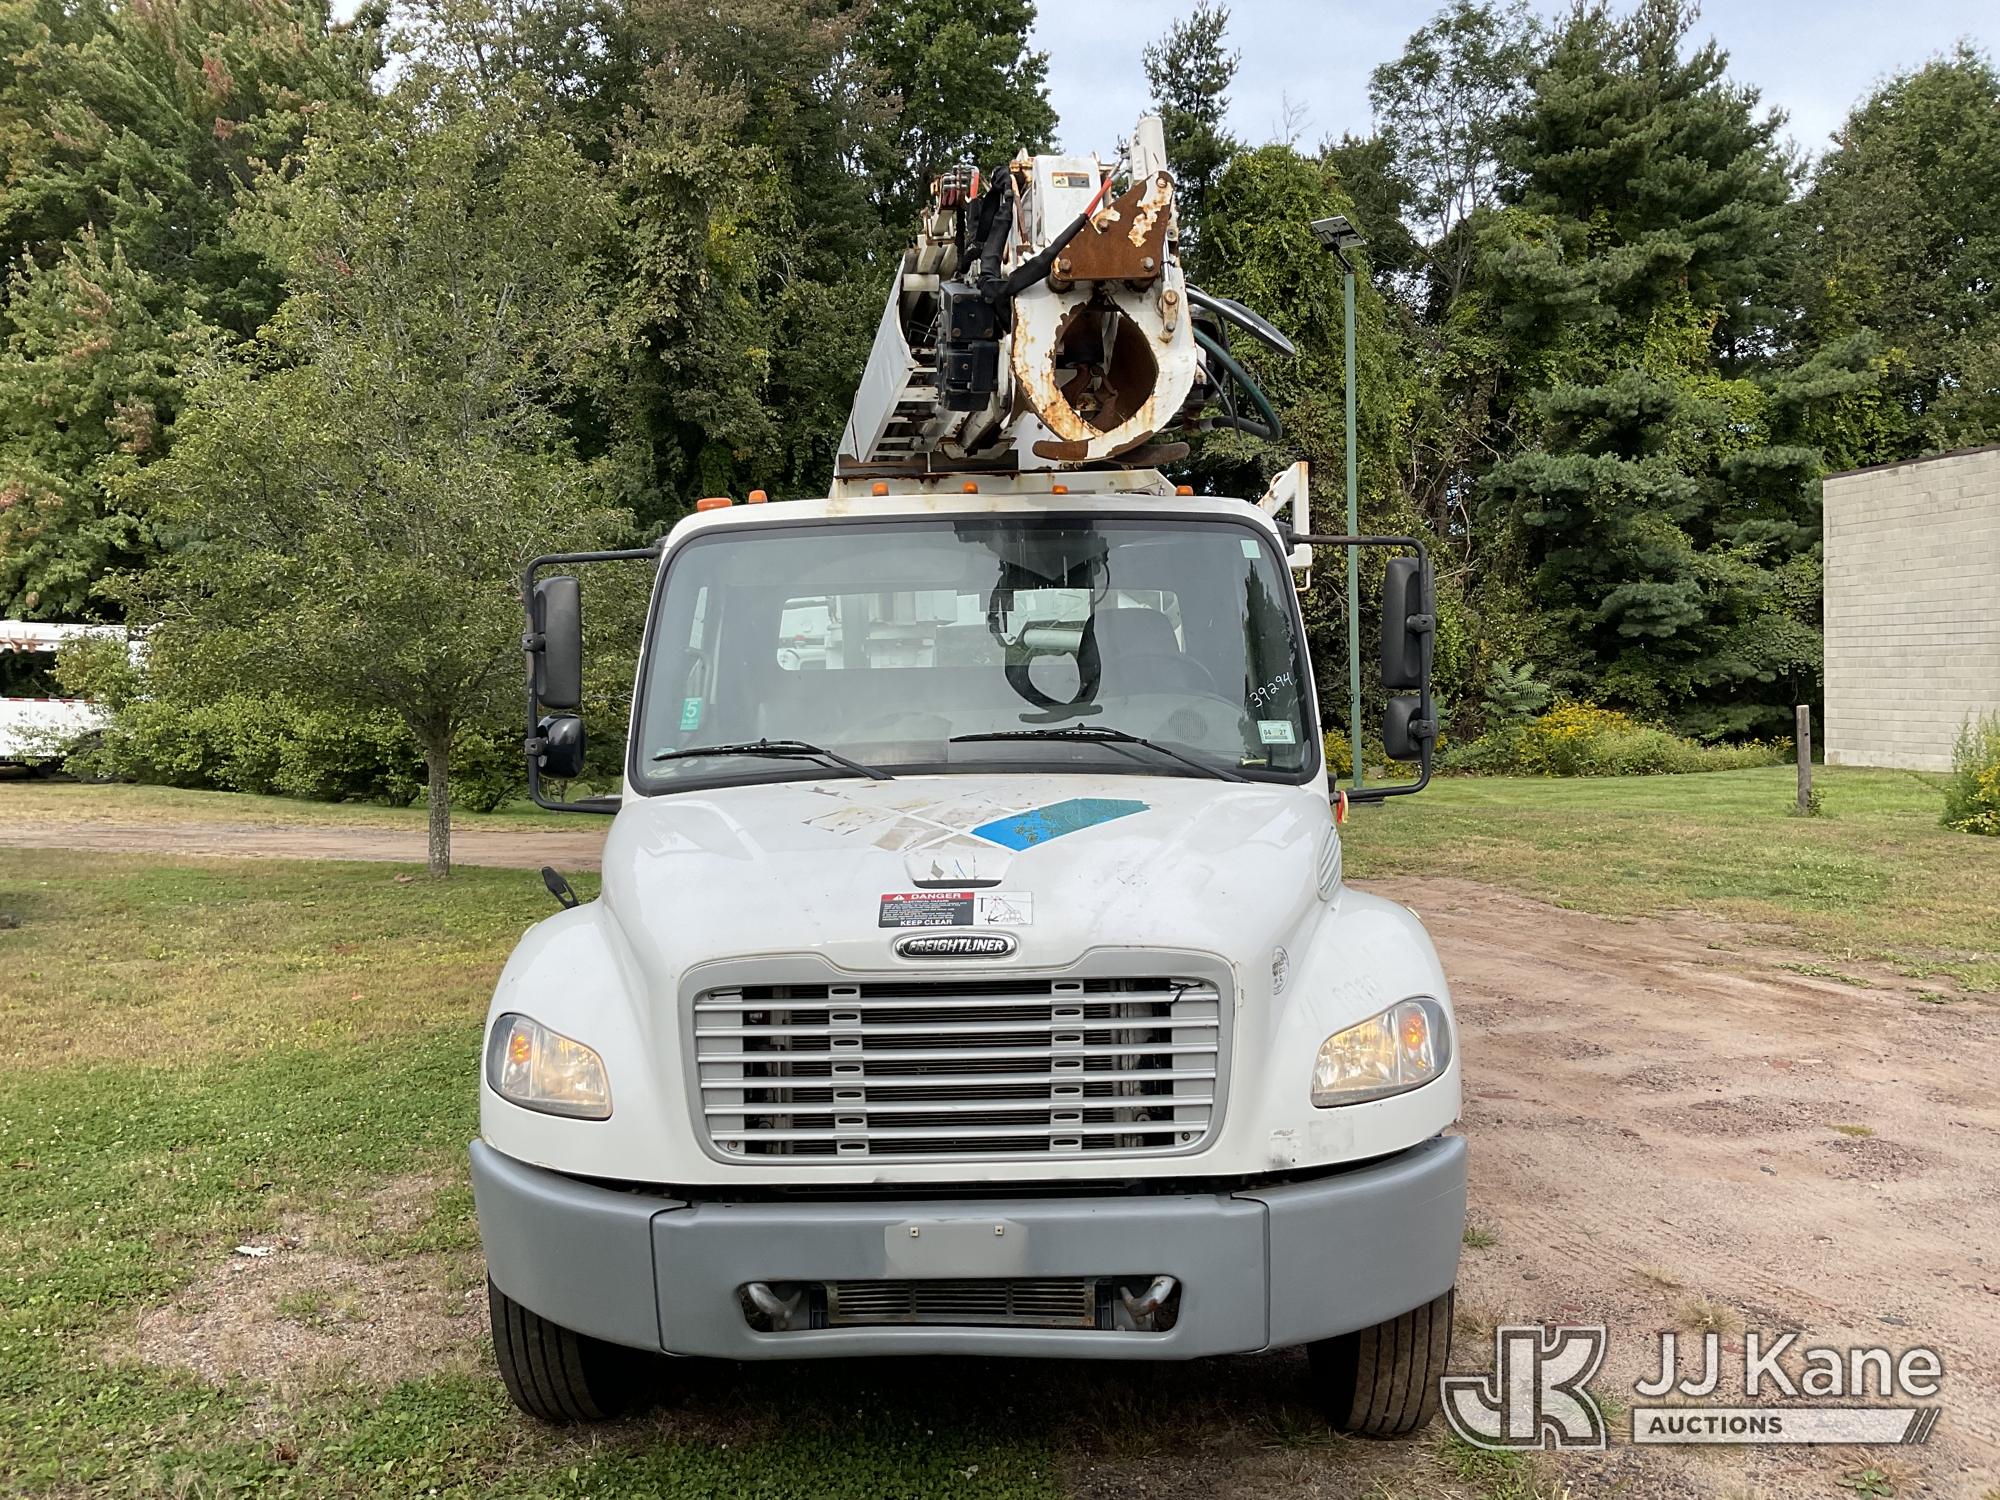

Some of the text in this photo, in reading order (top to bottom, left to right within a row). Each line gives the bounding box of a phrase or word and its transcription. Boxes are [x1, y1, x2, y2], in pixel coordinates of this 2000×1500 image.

[1249, 672, 1293, 707] 39294
[686, 701, 697, 717] 5
[908, 939, 1004, 953] FREIGHTLINER
